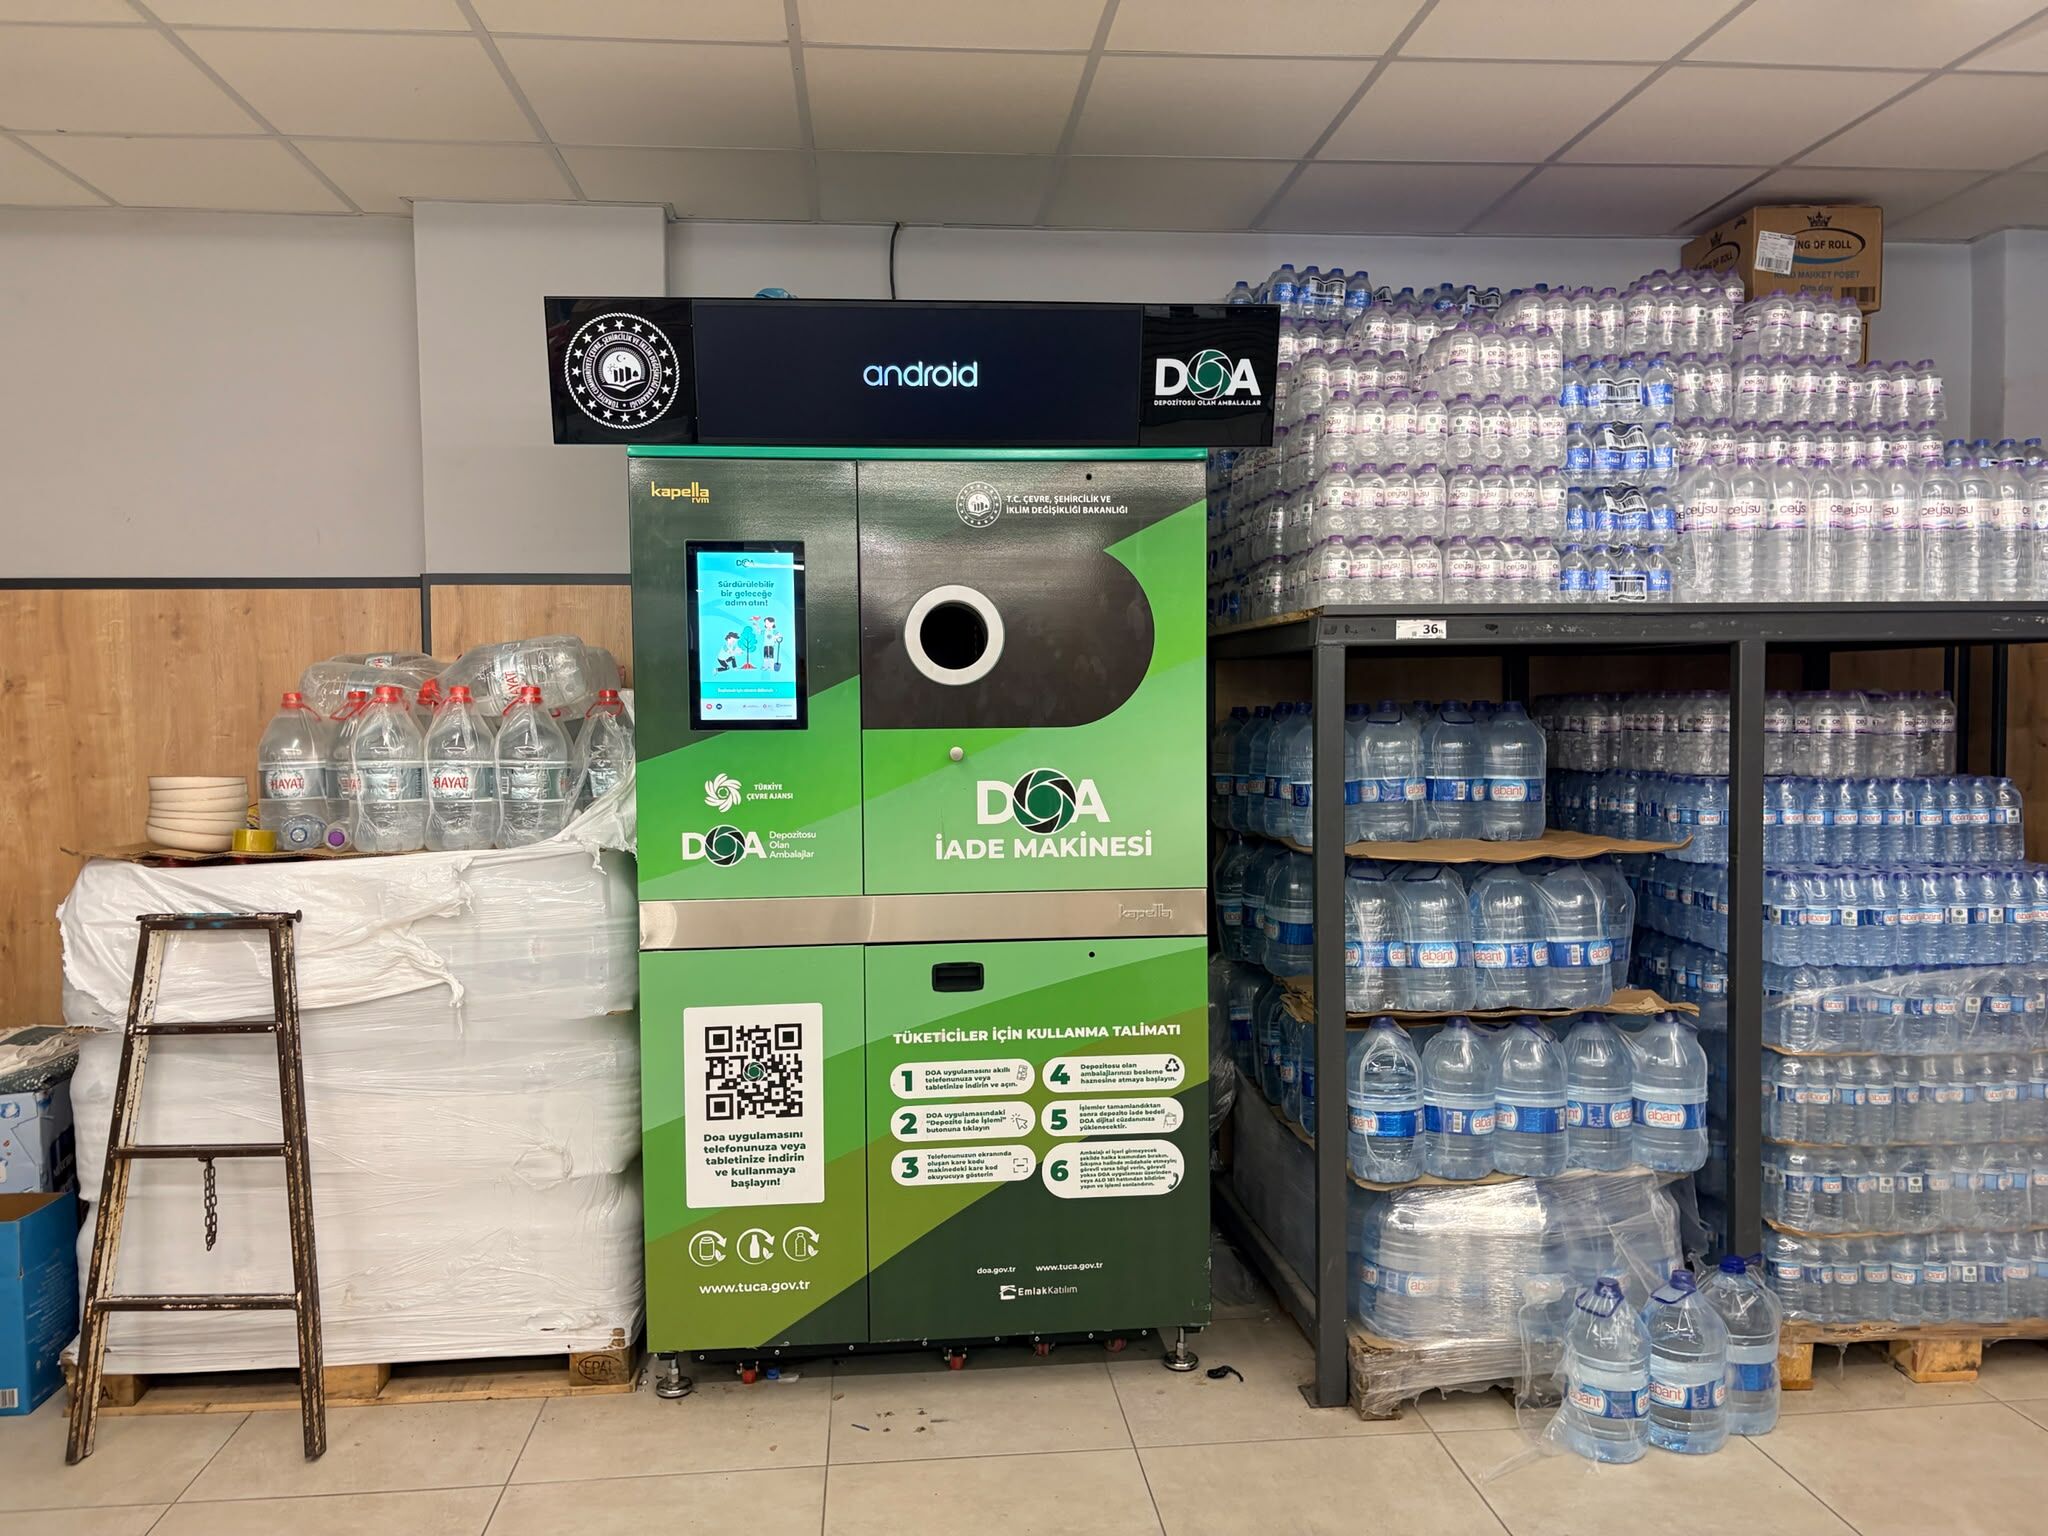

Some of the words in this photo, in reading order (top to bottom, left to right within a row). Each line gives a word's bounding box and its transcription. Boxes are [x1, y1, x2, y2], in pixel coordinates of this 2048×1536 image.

[1795, 240, 1810, 248] ING
[1814, 240, 1825, 248] OF
[1829, 240, 1851, 248] ROLL
[863, 361, 978, 386] android
[1155, 349, 1261, 400] DOA
[652, 481, 709, 500] kapella
[1006, 495, 1021, 503] T.C.
[1023, 495, 1051, 504] ÇEVRE,
[1054, 494, 1099, 504] ŞEHİRCİLİK
[1101, 495, 1111, 503] VE
[1006, 505, 1030, 514] İKLİM
[1032, 505, 1081, 515] DEĞİŞİKLİĞİ
[1082, 505, 1128, 513] BAKANLIĞI
[719, 580, 774, 588] Sürdürülebilir
[735, 590, 772, 599] geleceğe
[1423, 624, 1438, 634] 36
[271, 777, 304, 790] HAYAT
[433, 776, 468, 789] HAYAT
[754, 782, 783, 791] TÜRKİYE
[1493, 784, 1523, 796] abant
[747, 793, 768, 801] ÇEVRE
[976, 768, 1110, 835] DOA
[769, 830, 816, 839] Depozitosu
[682, 824, 767, 867] DOA
[769, 841, 790, 849] Olan
[936, 834, 1004, 860] İADE
[1014, 830, 1152, 858] MAKİNESİ
[769, 850, 815, 860] Ambalajlar
[1423, 948, 1454, 962] abant
[1475, 950, 1503, 962] abant
[893, 1028, 988, 1044] TÜKETİCİLER
[993, 1026, 1022, 1043] İÇİN
[1027, 1027, 1109, 1039] KULLANMA
[1112, 1022, 1180, 1036] TALİMATI
[1050, 1064, 1070, 1085] 4
[902, 1071, 912, 1091] 1
[945, 1110, 1005, 1118] uygulamasındaki
[1050, 1109, 1068, 1130] 5
[1648, 1110, 1682, 1123] abant
[900, 1112, 918, 1134] 2
[704, 1134, 725, 1142] Doa
[729, 1131, 803, 1142] uygulamasını
[704, 1144, 777, 1154] telefonunuza
[780, 1142, 806, 1151] veya
[706, 1155, 765, 1165] tabletinize
[768, 1153, 804, 1162] indirin
[715, 1168, 728, 1177] ve
[731, 1166, 796, 1176] kullanmaya
[902, 1157, 919, 1178] 3
[1050, 1160, 1069, 1182] 6
[731, 1179, 780, 1189] başlayın!
[977, 1266, 1016, 1274] doa.gov.tr
[1036, 1262, 1103, 1271] www.tuca.gov.tr
[699, 1280, 810, 1294] www.tuca.gov.tr
[1649, 1382, 1681, 1400] abant
[1570, 1391, 1601, 1409] abant
